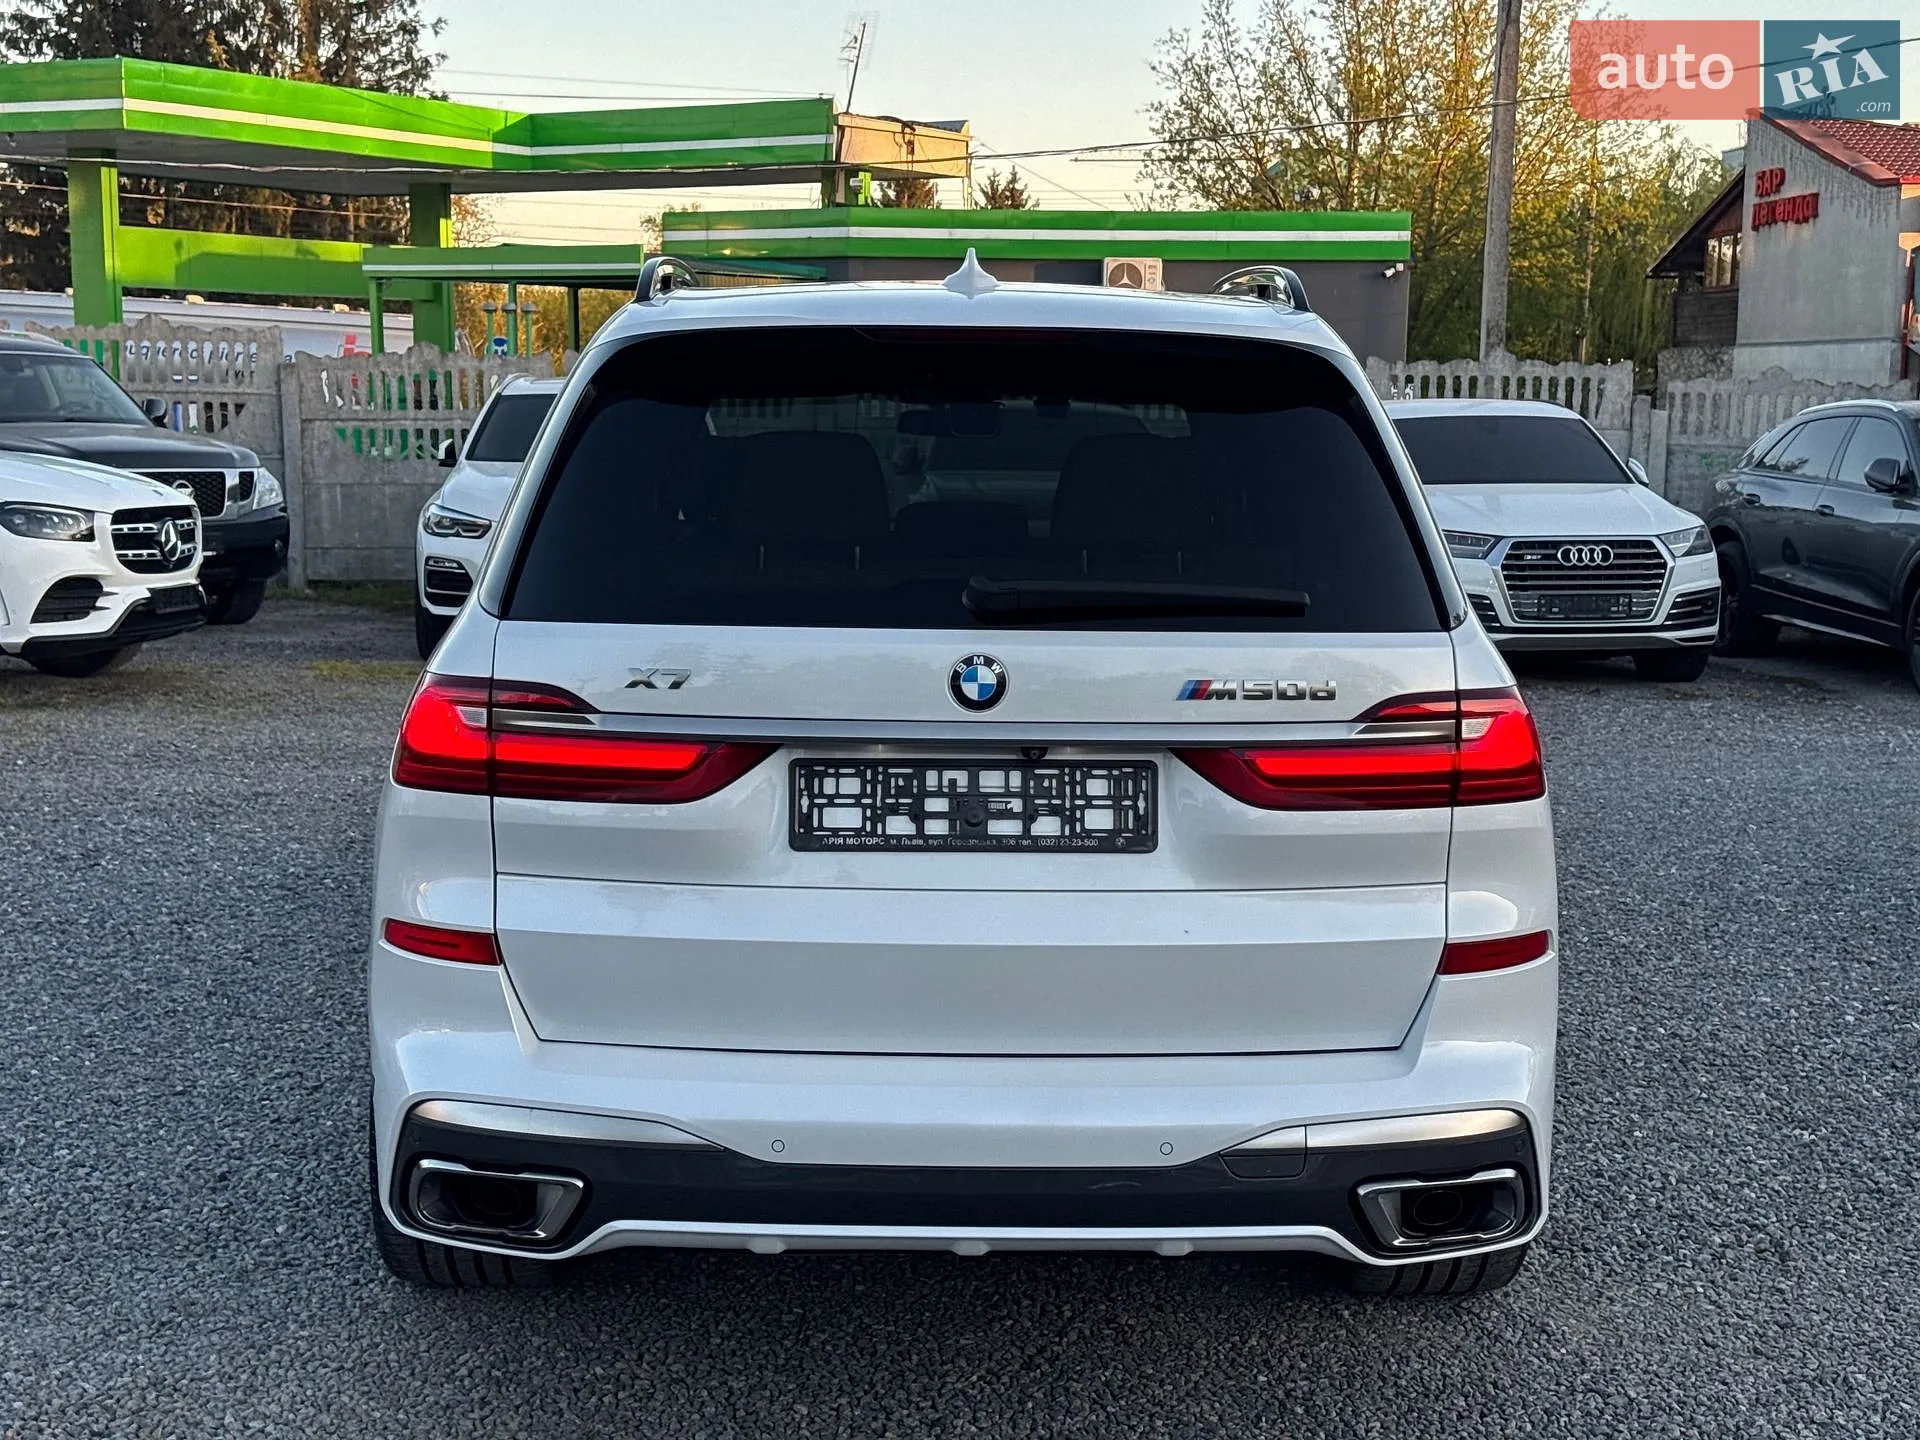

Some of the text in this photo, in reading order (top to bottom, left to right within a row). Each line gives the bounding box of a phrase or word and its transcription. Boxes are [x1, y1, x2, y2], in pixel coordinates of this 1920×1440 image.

[1755, 167, 1786, 197] БАР
[955, 655, 1003, 674] BMW
[624, 667, 691, 689] X7
[845, 837, 885, 845] МОТОРС
[1037, 837, 1058, 847] (032)
[1059, 837, 1099, 846] 23-23-500
